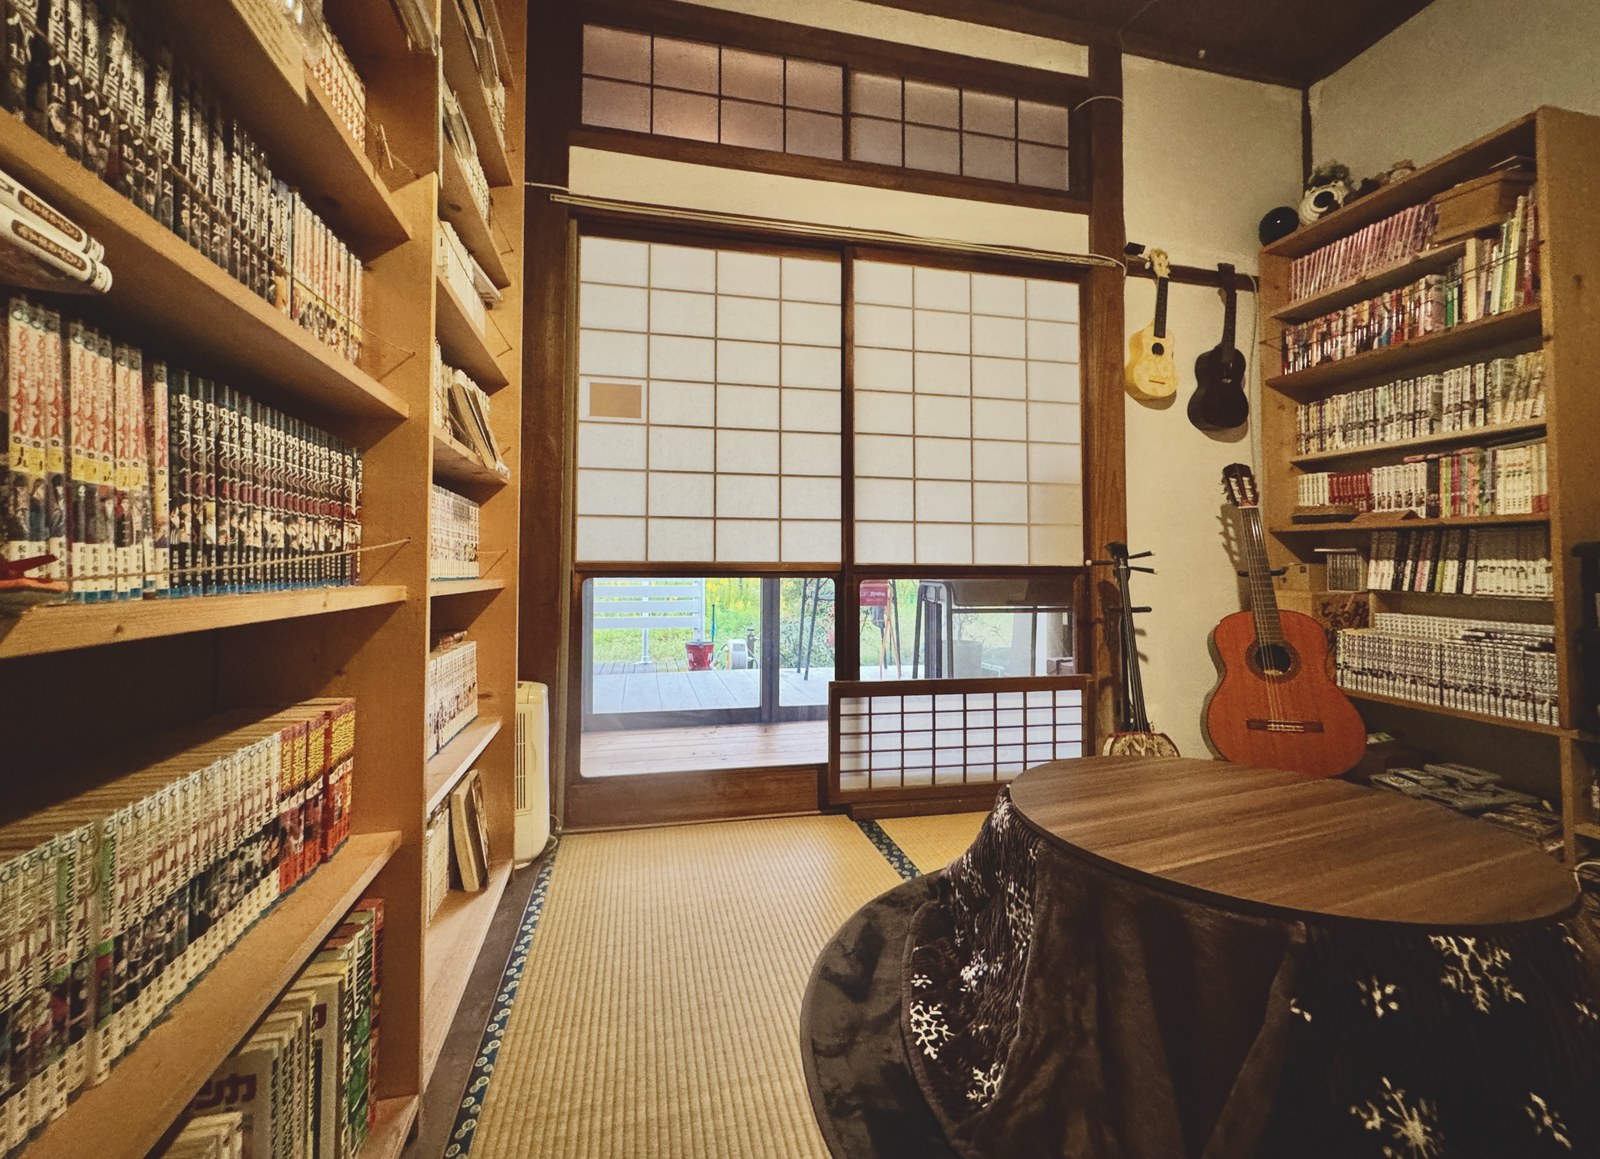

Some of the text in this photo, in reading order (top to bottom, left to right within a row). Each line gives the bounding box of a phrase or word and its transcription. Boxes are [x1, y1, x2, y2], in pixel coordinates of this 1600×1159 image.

[179, 394, 191, 446] 鬼滅の刃
[192, 399, 204, 450] 鬼滅の刃
